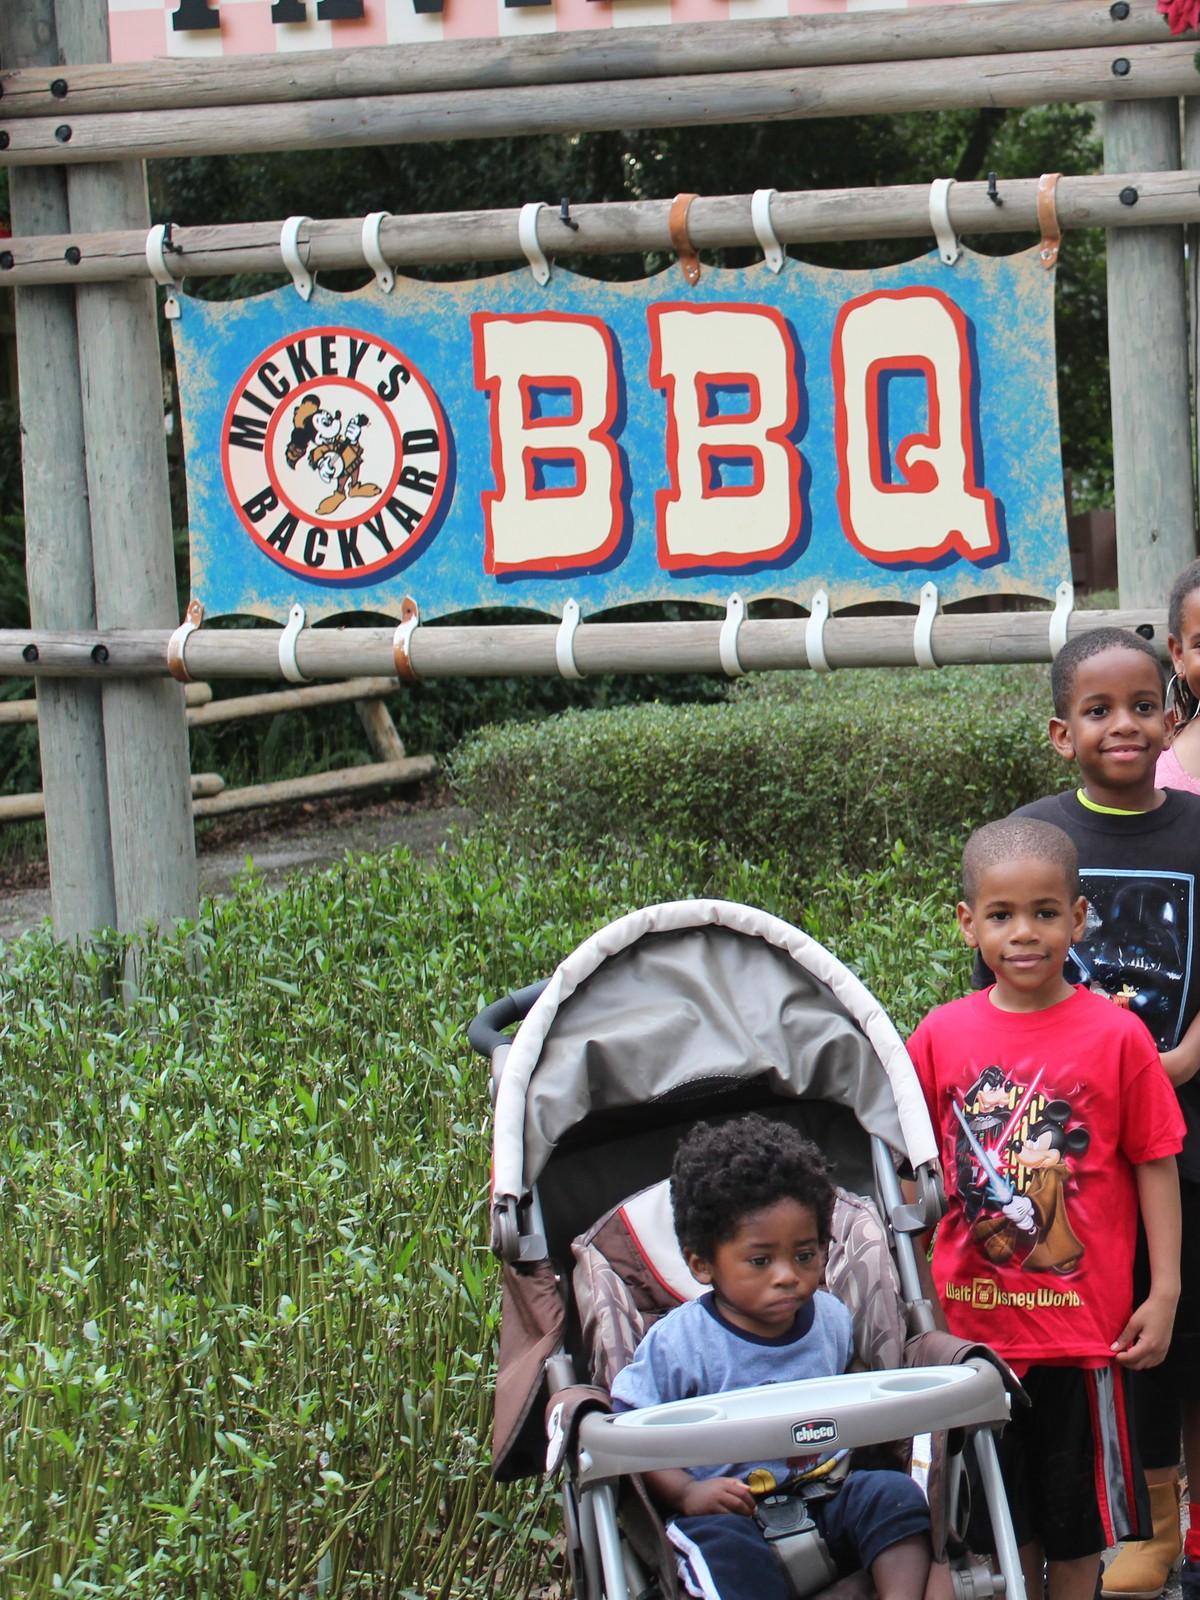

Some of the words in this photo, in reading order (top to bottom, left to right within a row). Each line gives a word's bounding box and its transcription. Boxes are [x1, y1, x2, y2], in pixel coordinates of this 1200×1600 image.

[229, 336, 410, 451] MICKEY'S
[471, 287, 1000, 576] BBQ
[242, 429, 440, 569] BACKYARD
[945, 1281, 971, 1302] Walt
[972, 1278, 1035, 1310] Disney
[795, 1424, 835, 1442] chicco
